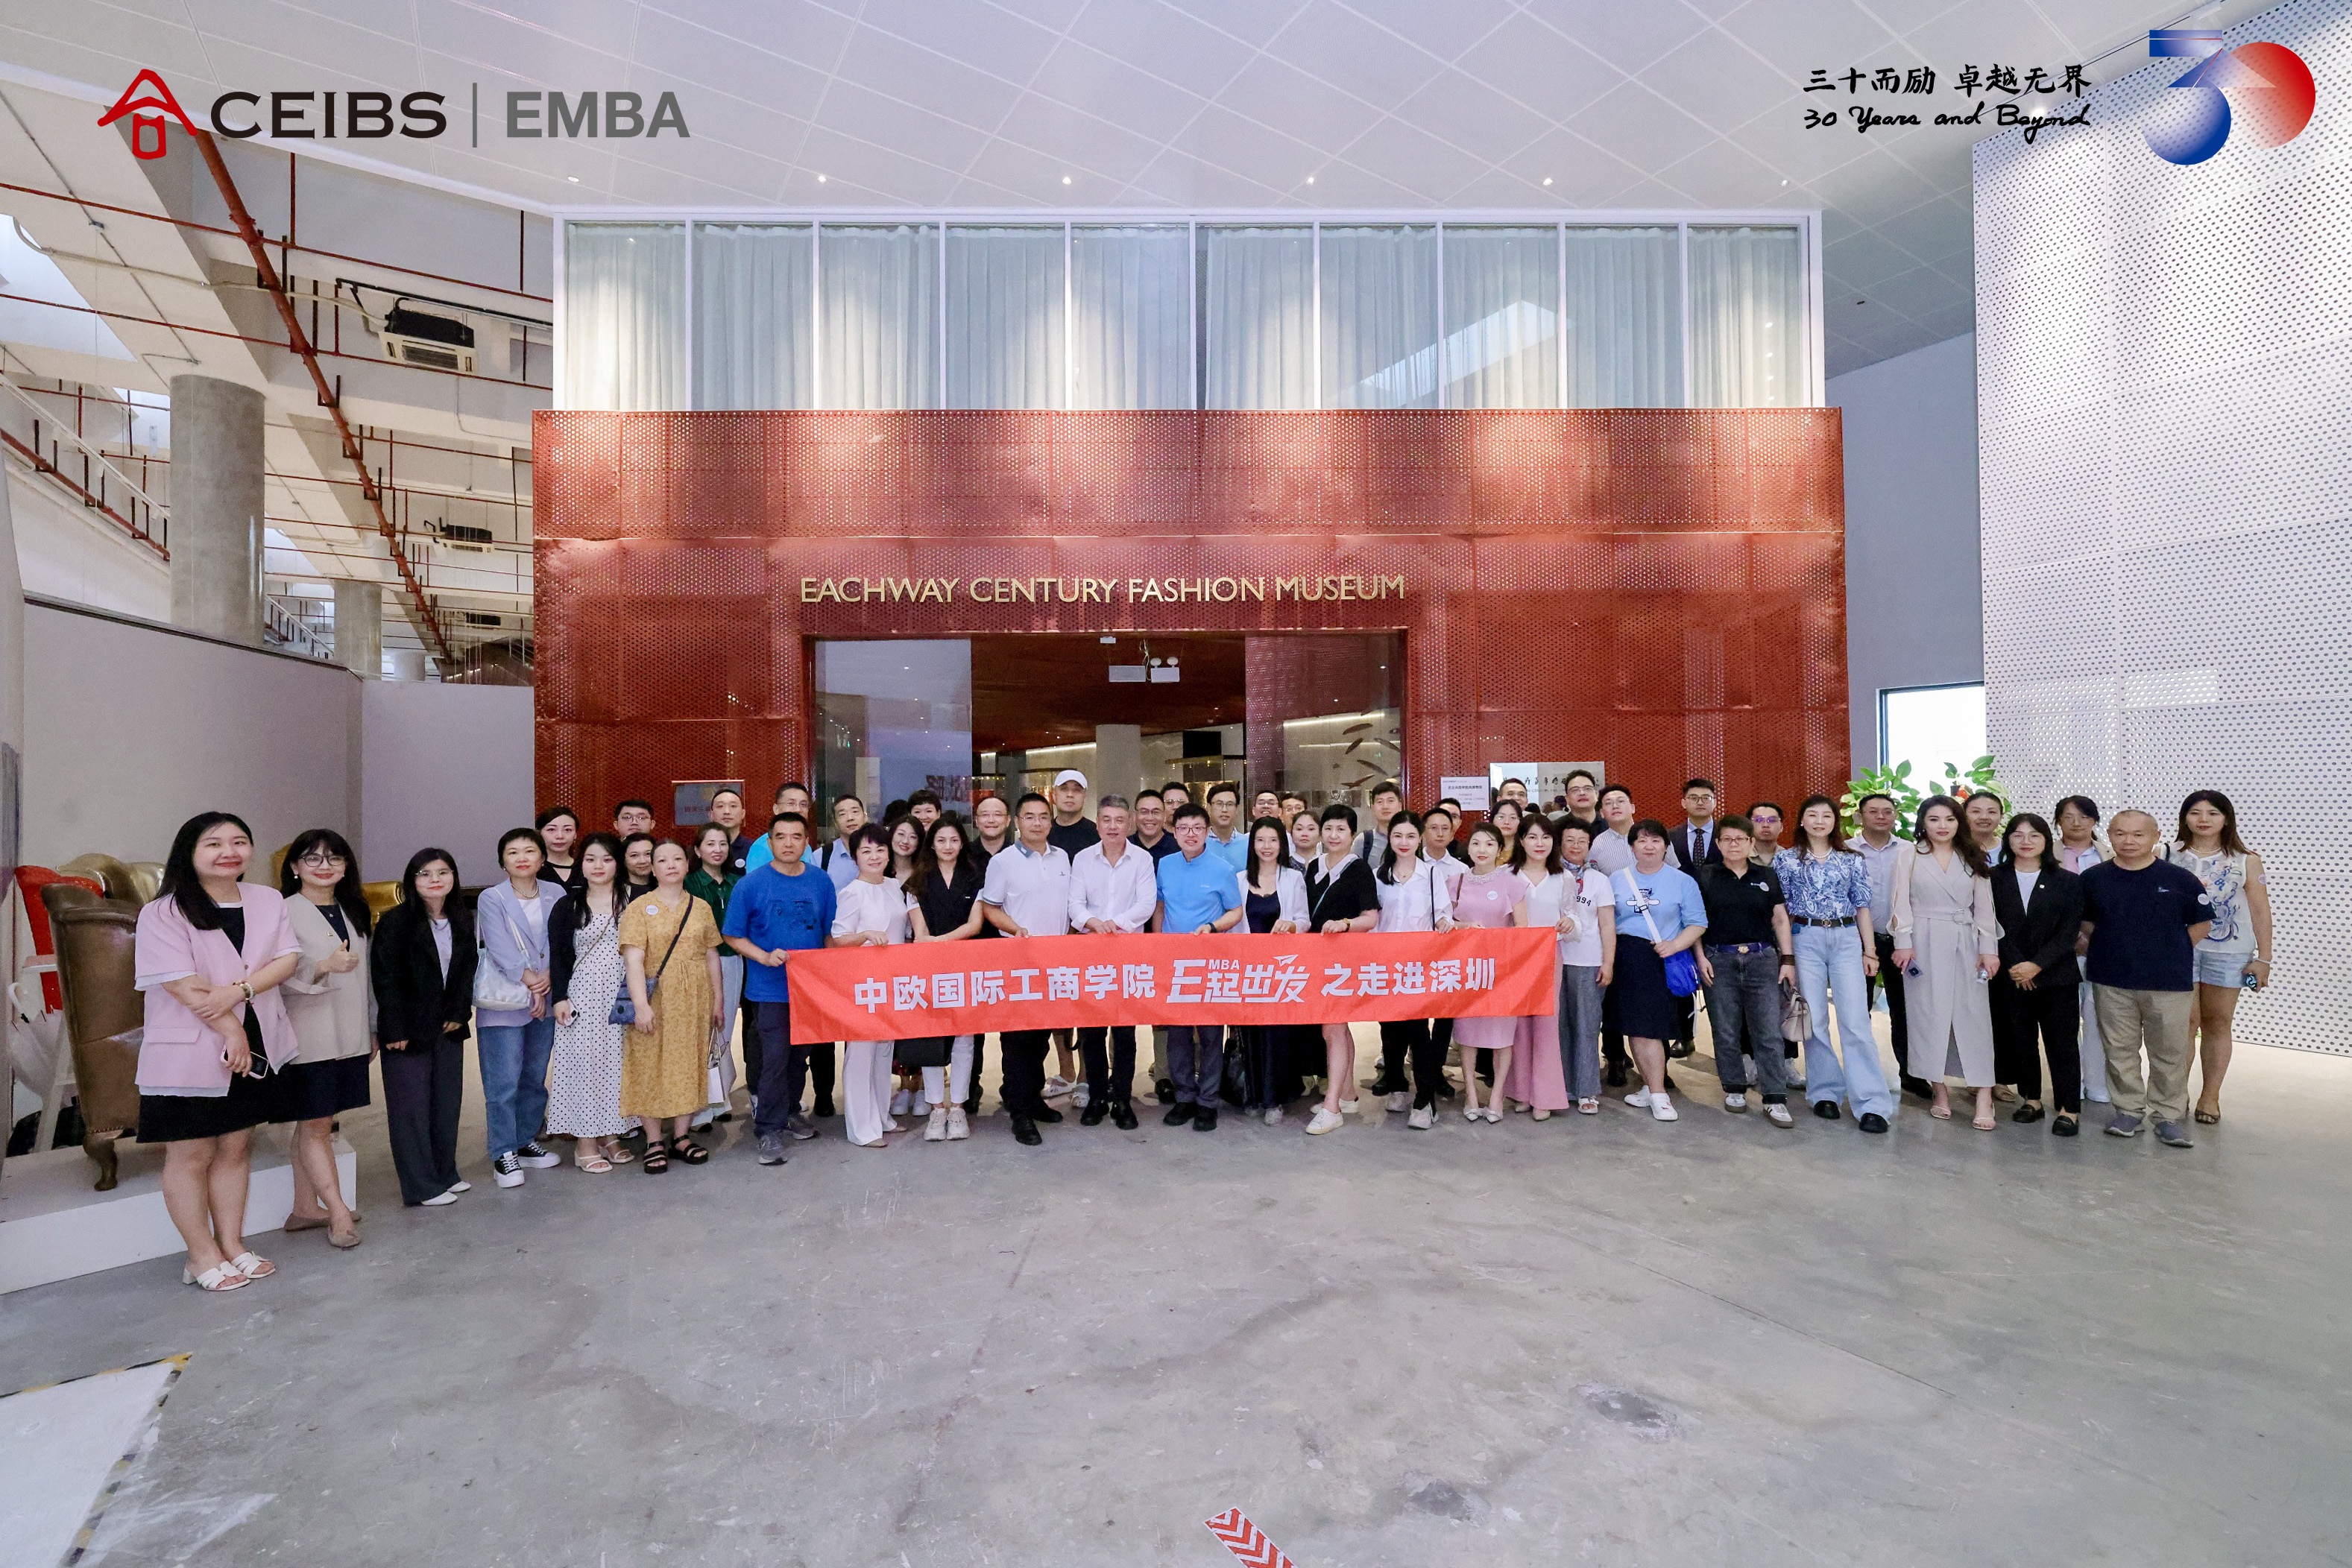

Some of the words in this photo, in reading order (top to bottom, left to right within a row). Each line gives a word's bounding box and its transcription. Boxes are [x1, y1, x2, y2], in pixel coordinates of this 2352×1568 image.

[800, 577, 960, 603] EACHWAY
[969, 577, 1117, 603] CENTURY
[1128, 576, 1265, 603] FASHION
[1276, 574, 1405, 601] MUSEUM
[1208, 958, 1240, 970] MBA
[854, 963, 1156, 1014] 中欧国际工商学院
[1320, 957, 1495, 997] 之走进深圳
